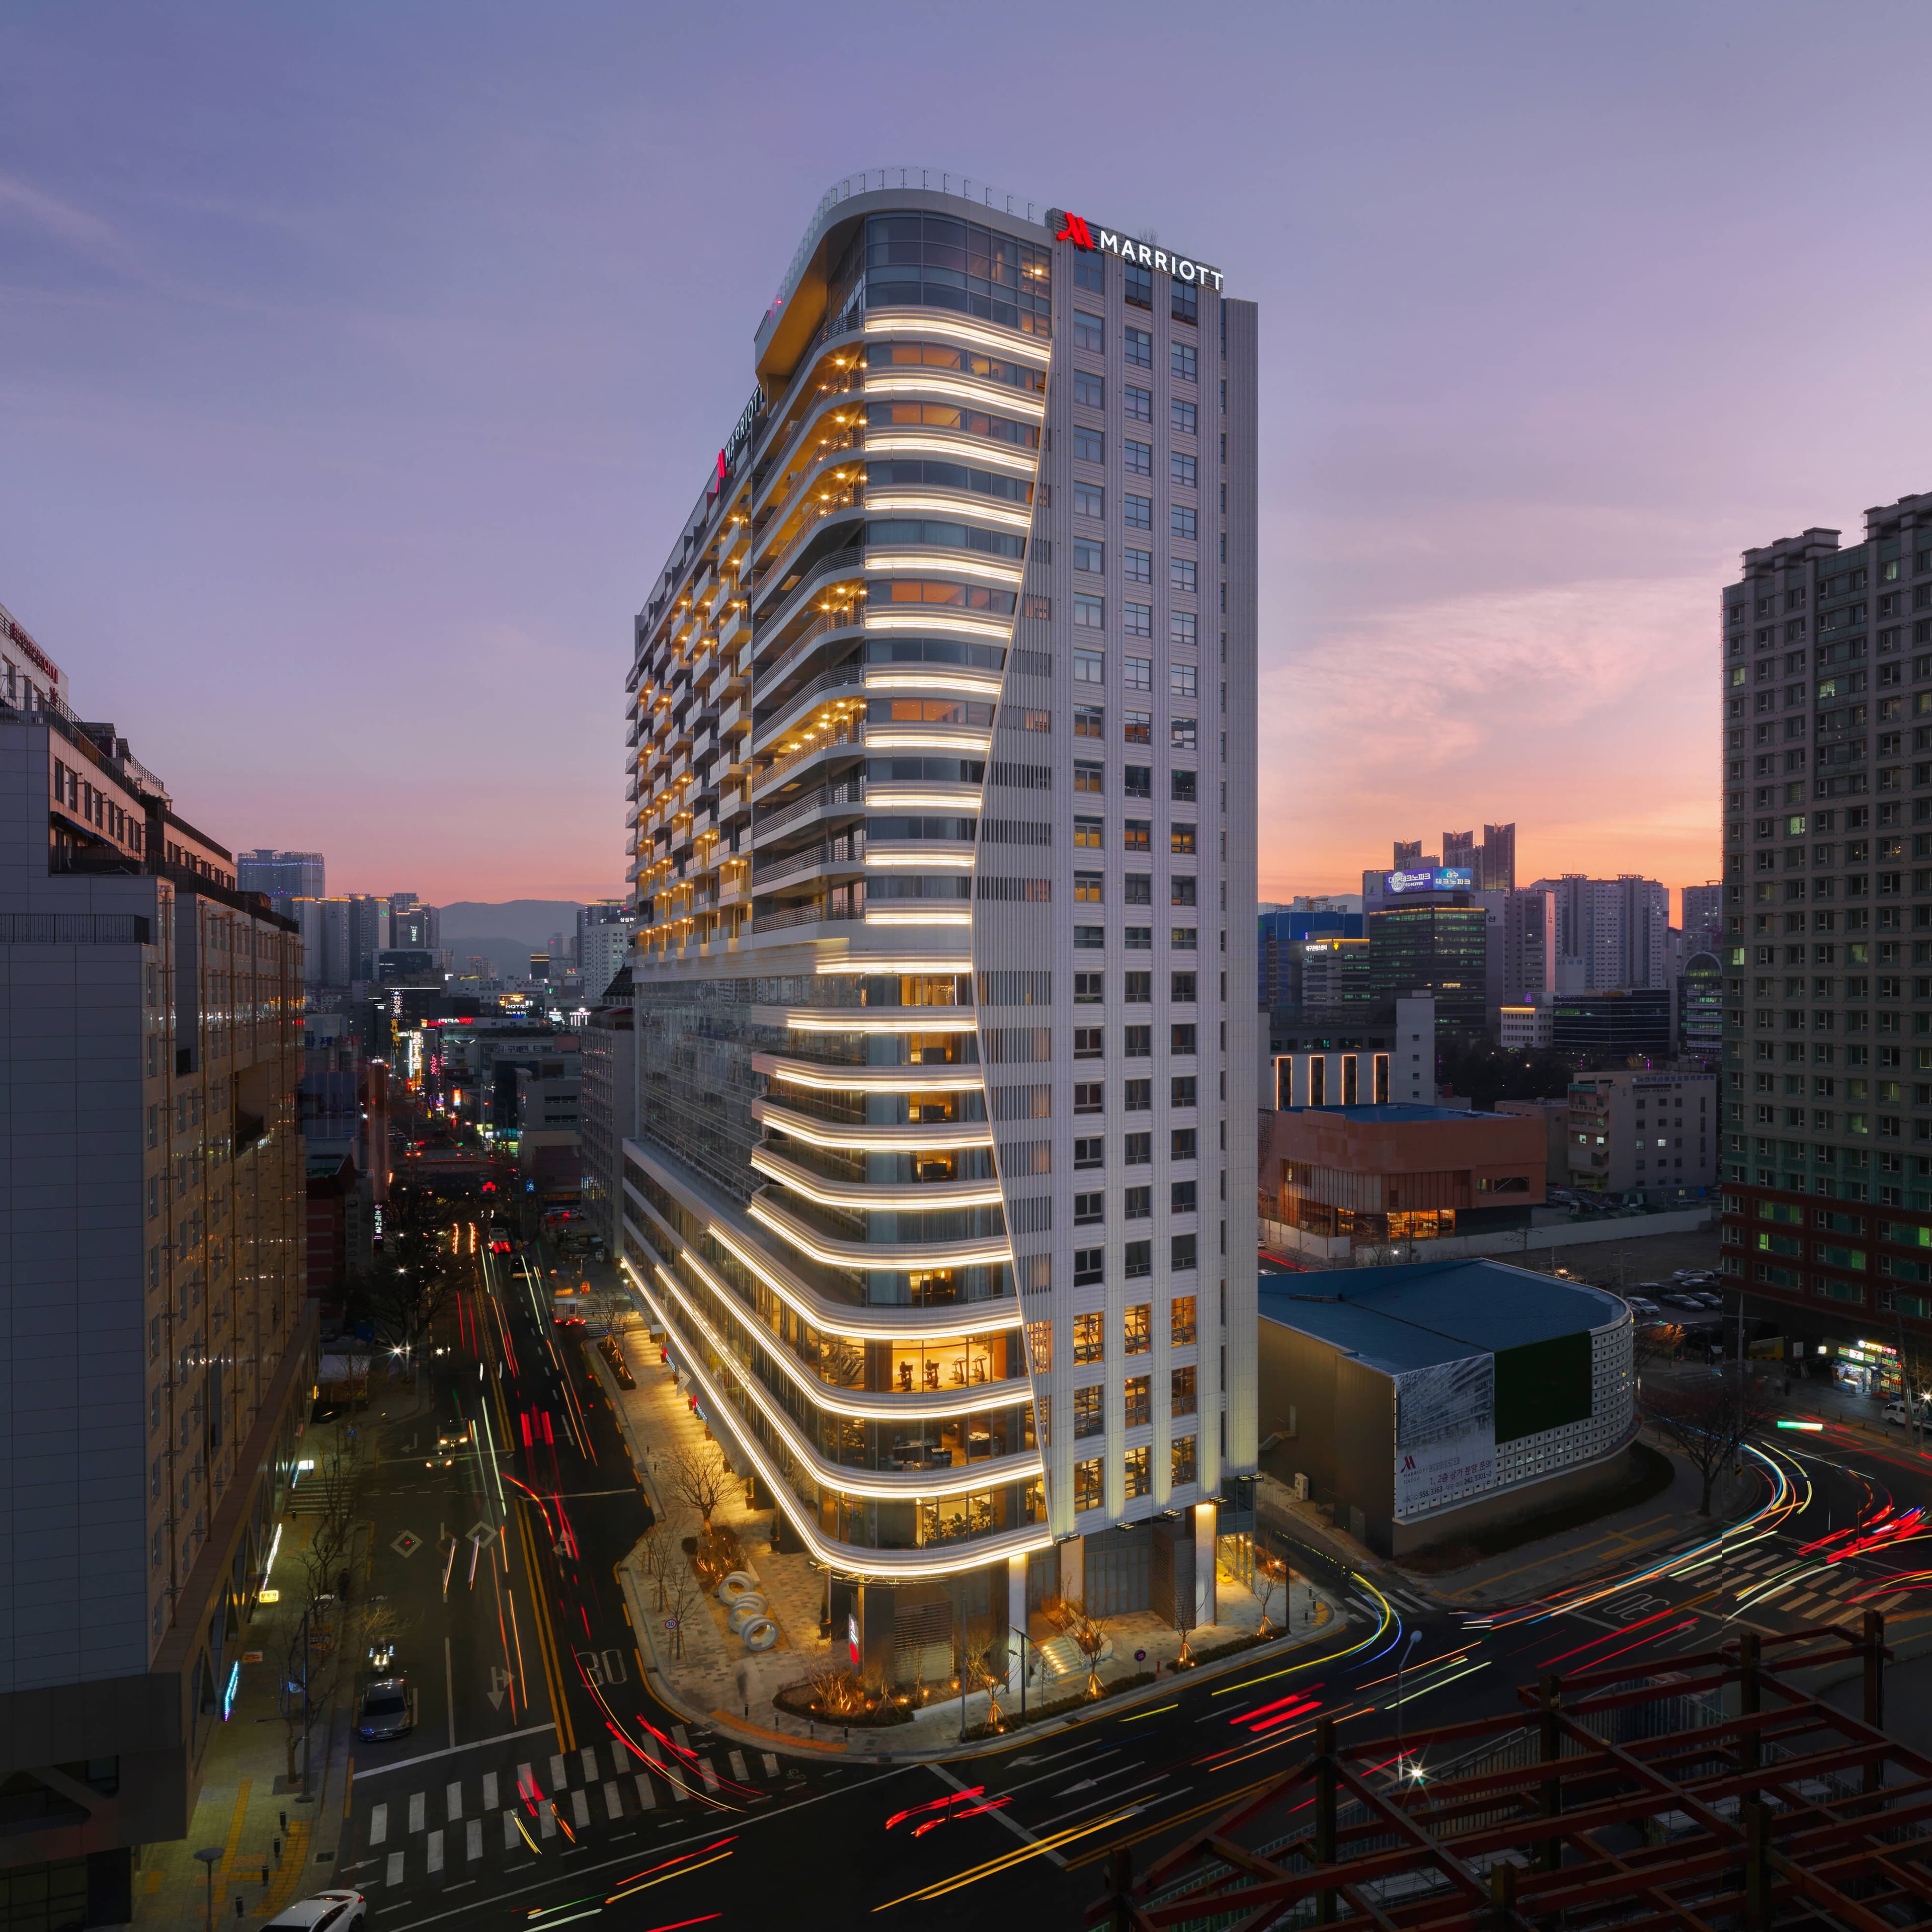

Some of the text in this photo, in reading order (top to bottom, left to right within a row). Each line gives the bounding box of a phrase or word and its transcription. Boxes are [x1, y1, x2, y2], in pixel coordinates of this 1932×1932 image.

[1100, 230, 1224, 290] MARRIOTT
[1388, 873, 1431, 883] 대구테크노파크
[1437, 1473, 1448, 1483] 2층
[1450, 1468, 1464, 1480] 상가
[1465, 1464, 1478, 1476] 분양
[1479, 1458, 1492, 1471] 문의
[1430, 1486, 1443, 1495] 3363
[576, 1648, 628, 1688] 30
